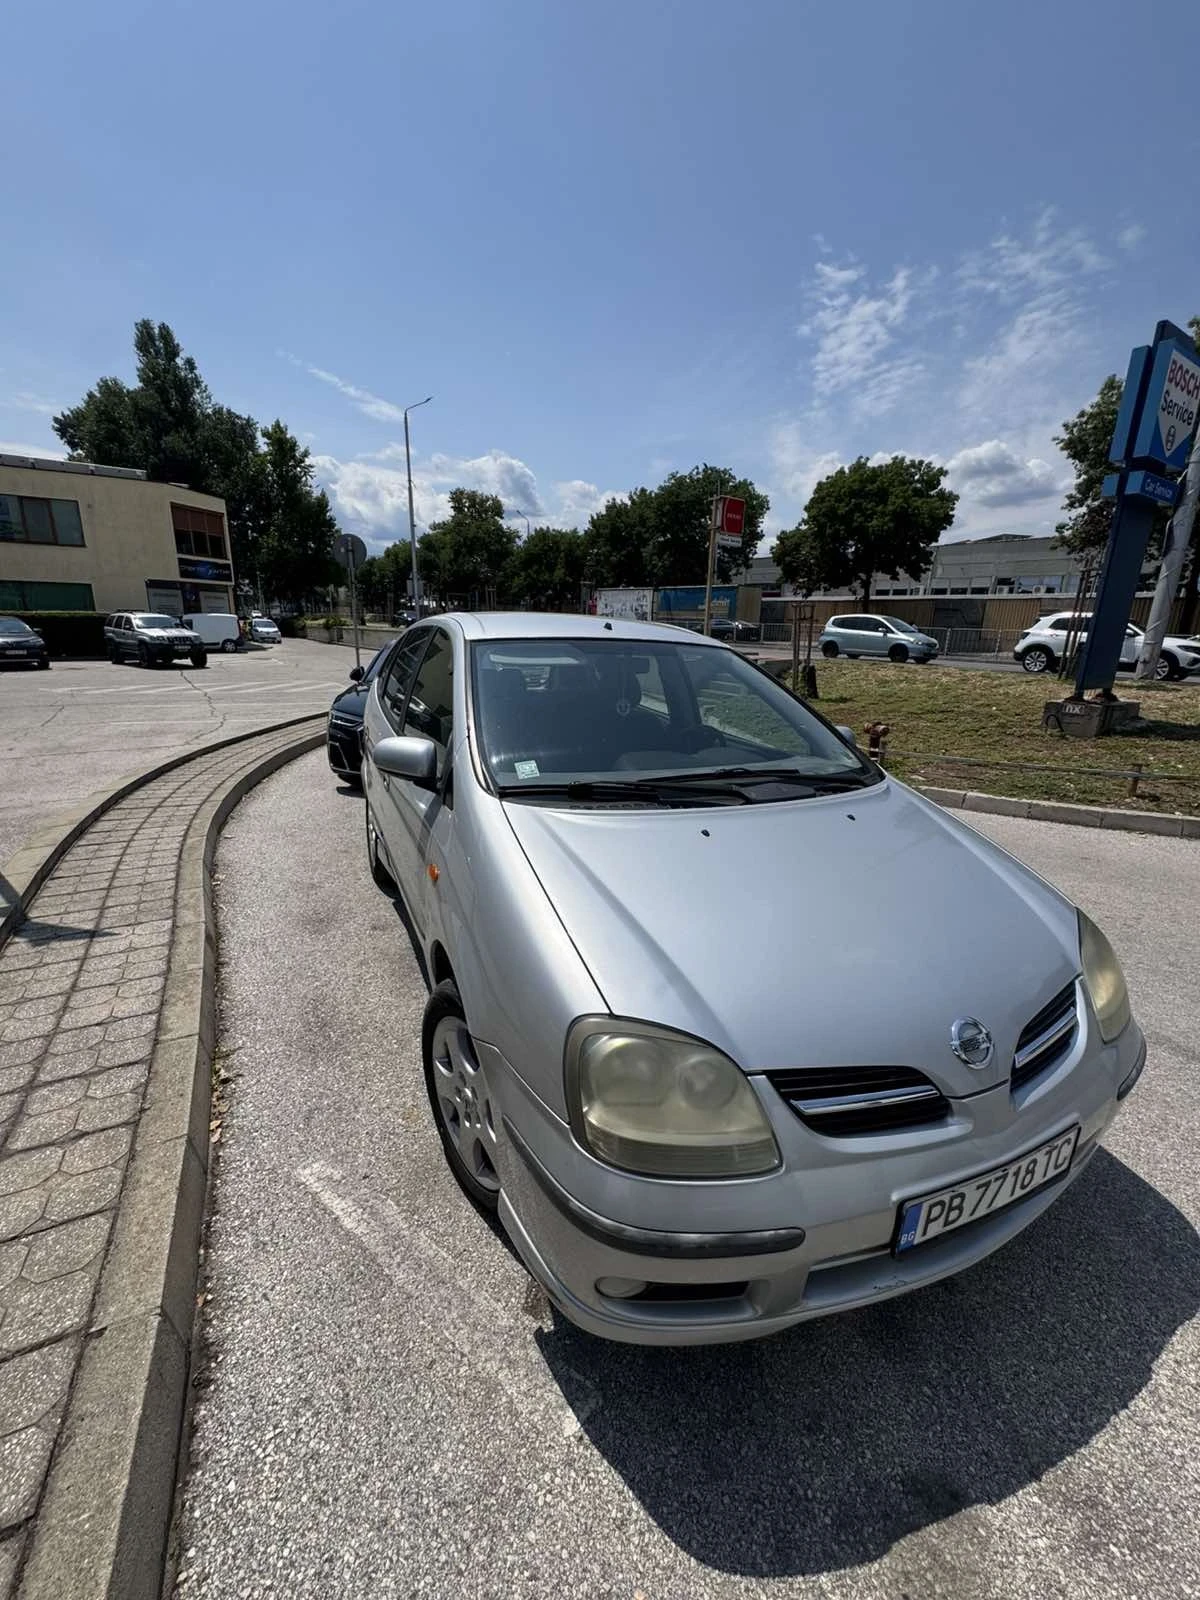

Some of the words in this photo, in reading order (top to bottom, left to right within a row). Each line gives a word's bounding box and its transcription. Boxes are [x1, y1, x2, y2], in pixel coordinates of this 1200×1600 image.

[1167, 358, 1200, 399] BOSCH
[1161, 389, 1194, 426] Service
[900, 1231, 915, 1245] BG
